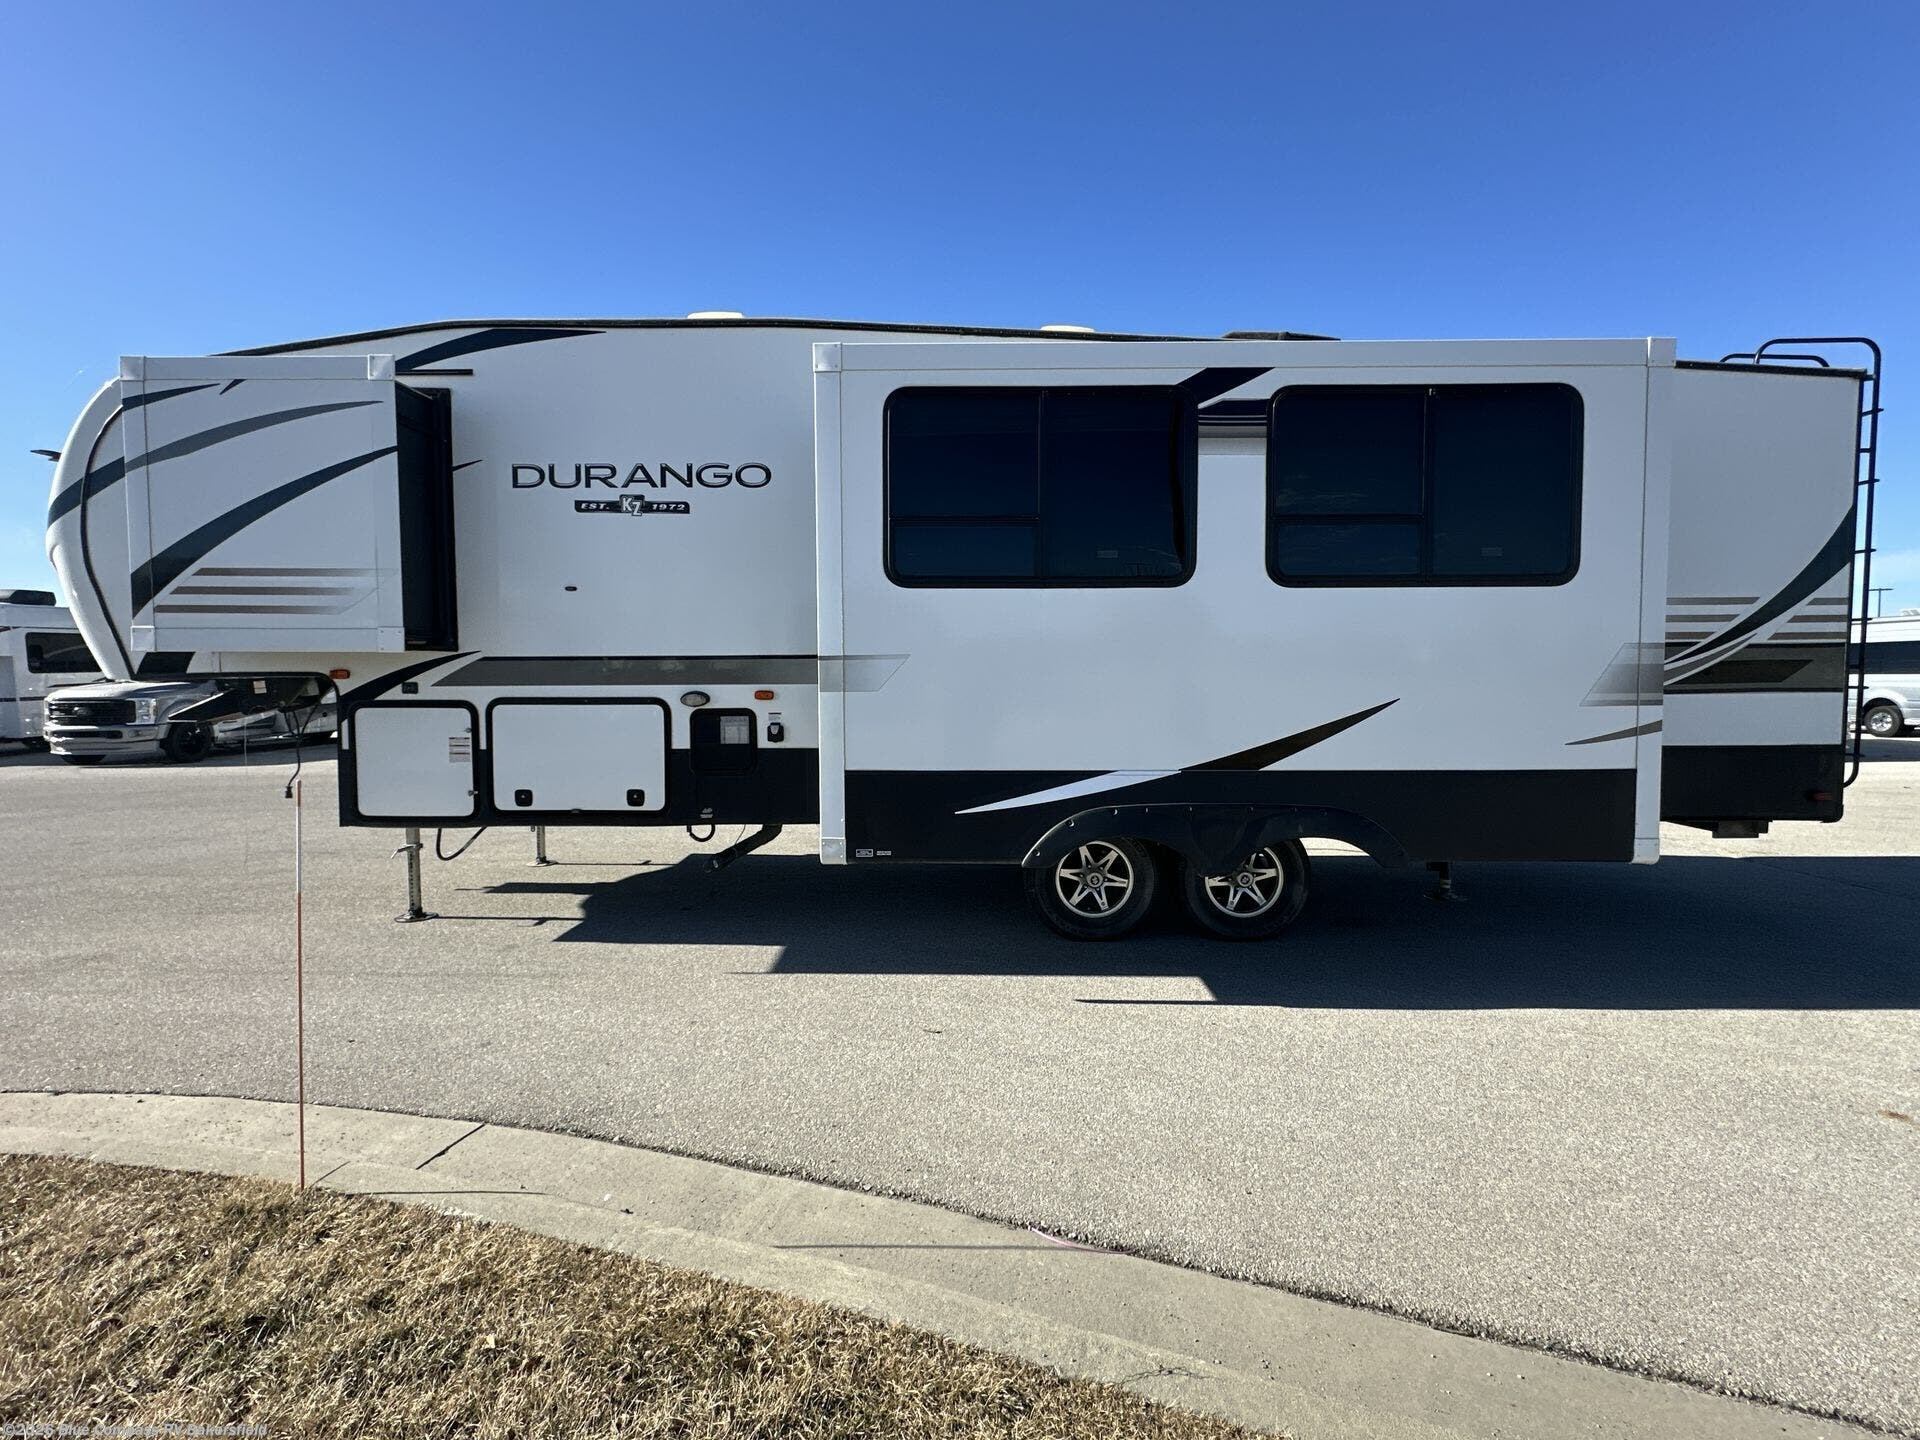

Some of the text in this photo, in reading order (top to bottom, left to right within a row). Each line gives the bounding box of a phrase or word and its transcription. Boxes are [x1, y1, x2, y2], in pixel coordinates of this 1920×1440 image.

[511, 462, 773, 489] DURANGO
[580, 496, 686, 516] EST. KZ 1972
